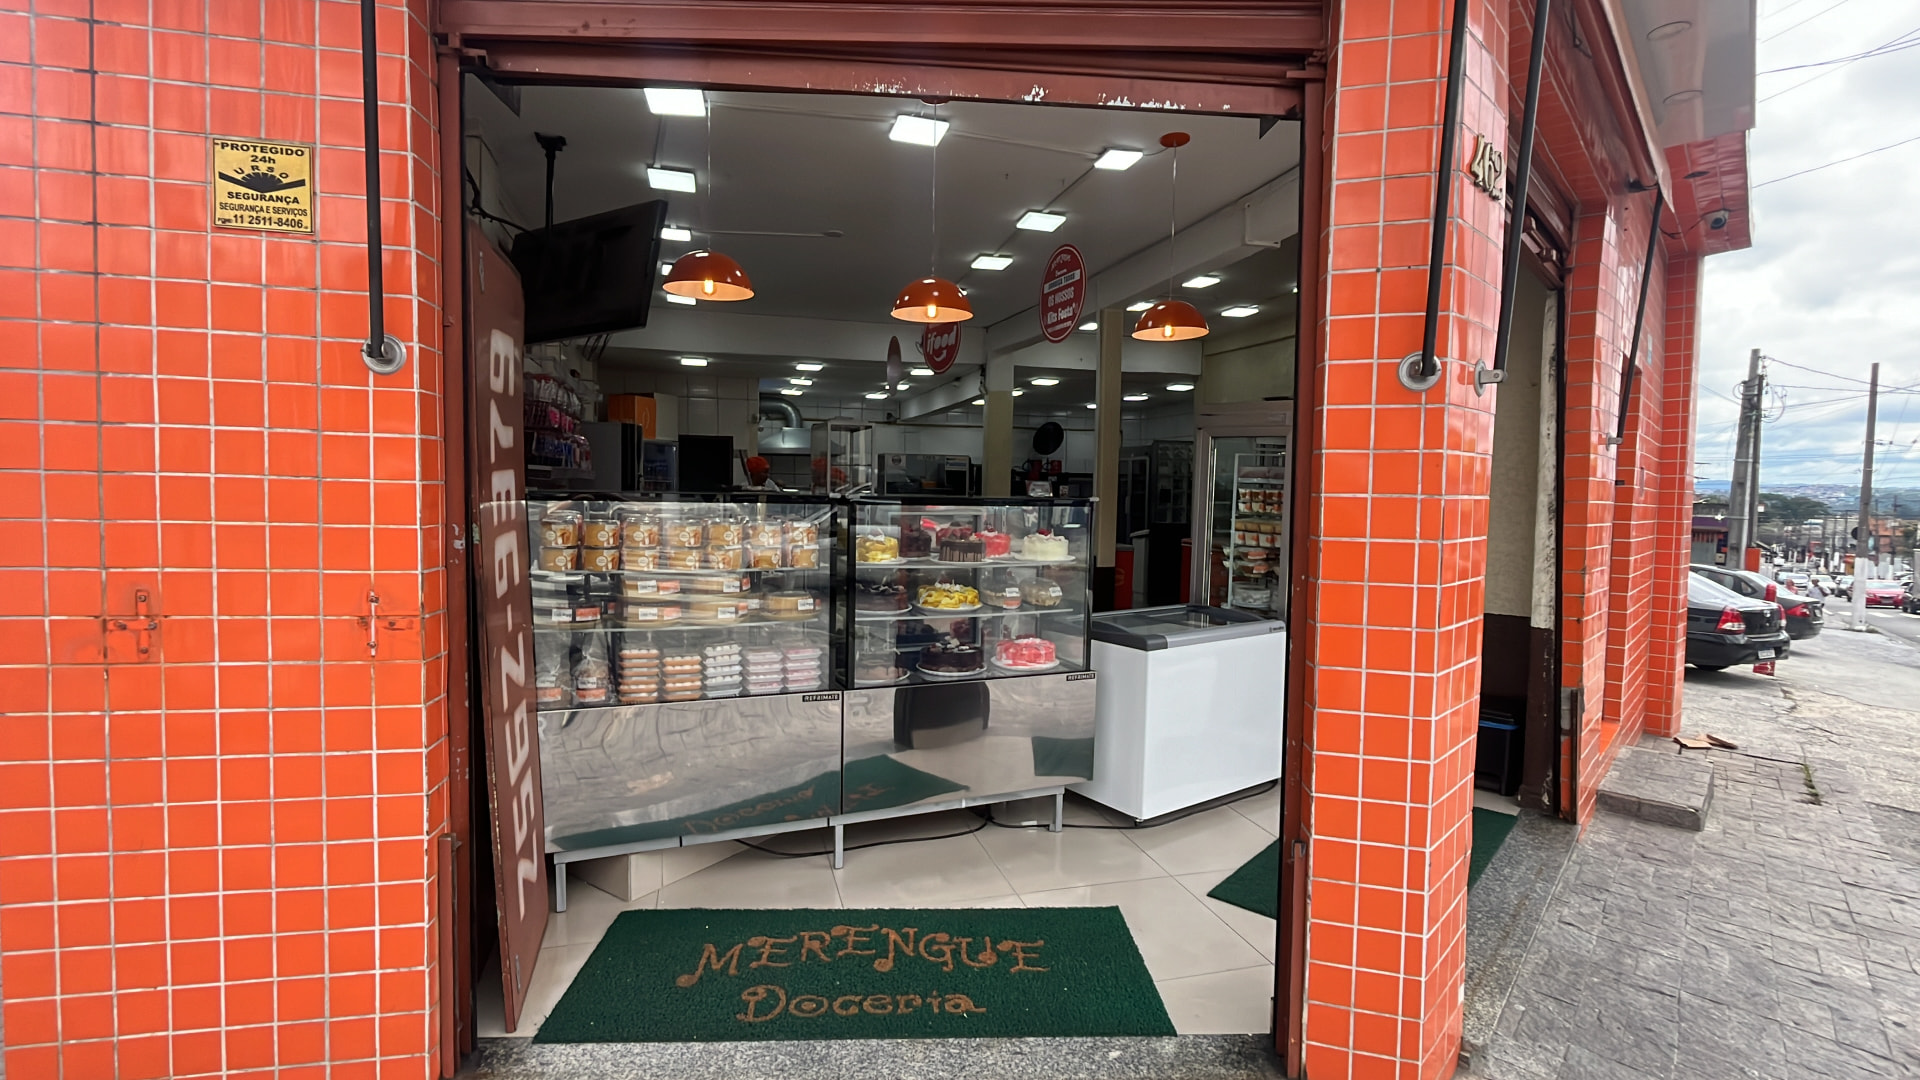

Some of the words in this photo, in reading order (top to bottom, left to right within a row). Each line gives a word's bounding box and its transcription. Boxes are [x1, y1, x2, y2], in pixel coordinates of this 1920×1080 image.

[220, 142, 304, 156] PROTEGIDO
[250, 155, 276, 164] 24h
[227, 191, 300, 205] SEGURANÇA
[219, 202, 265, 214] SEGURANÇA
[266, 205, 273, 213] E
[272, 206, 308, 218] SERVIÇOS
[233, 214, 245, 224] 11
[248, 215, 303, 229] 2511-8406
[490, 328, 539, 922] 2562-9379
[675, 923, 1051, 988] MERENGUE
[735, 984, 987, 1023] Doceria
